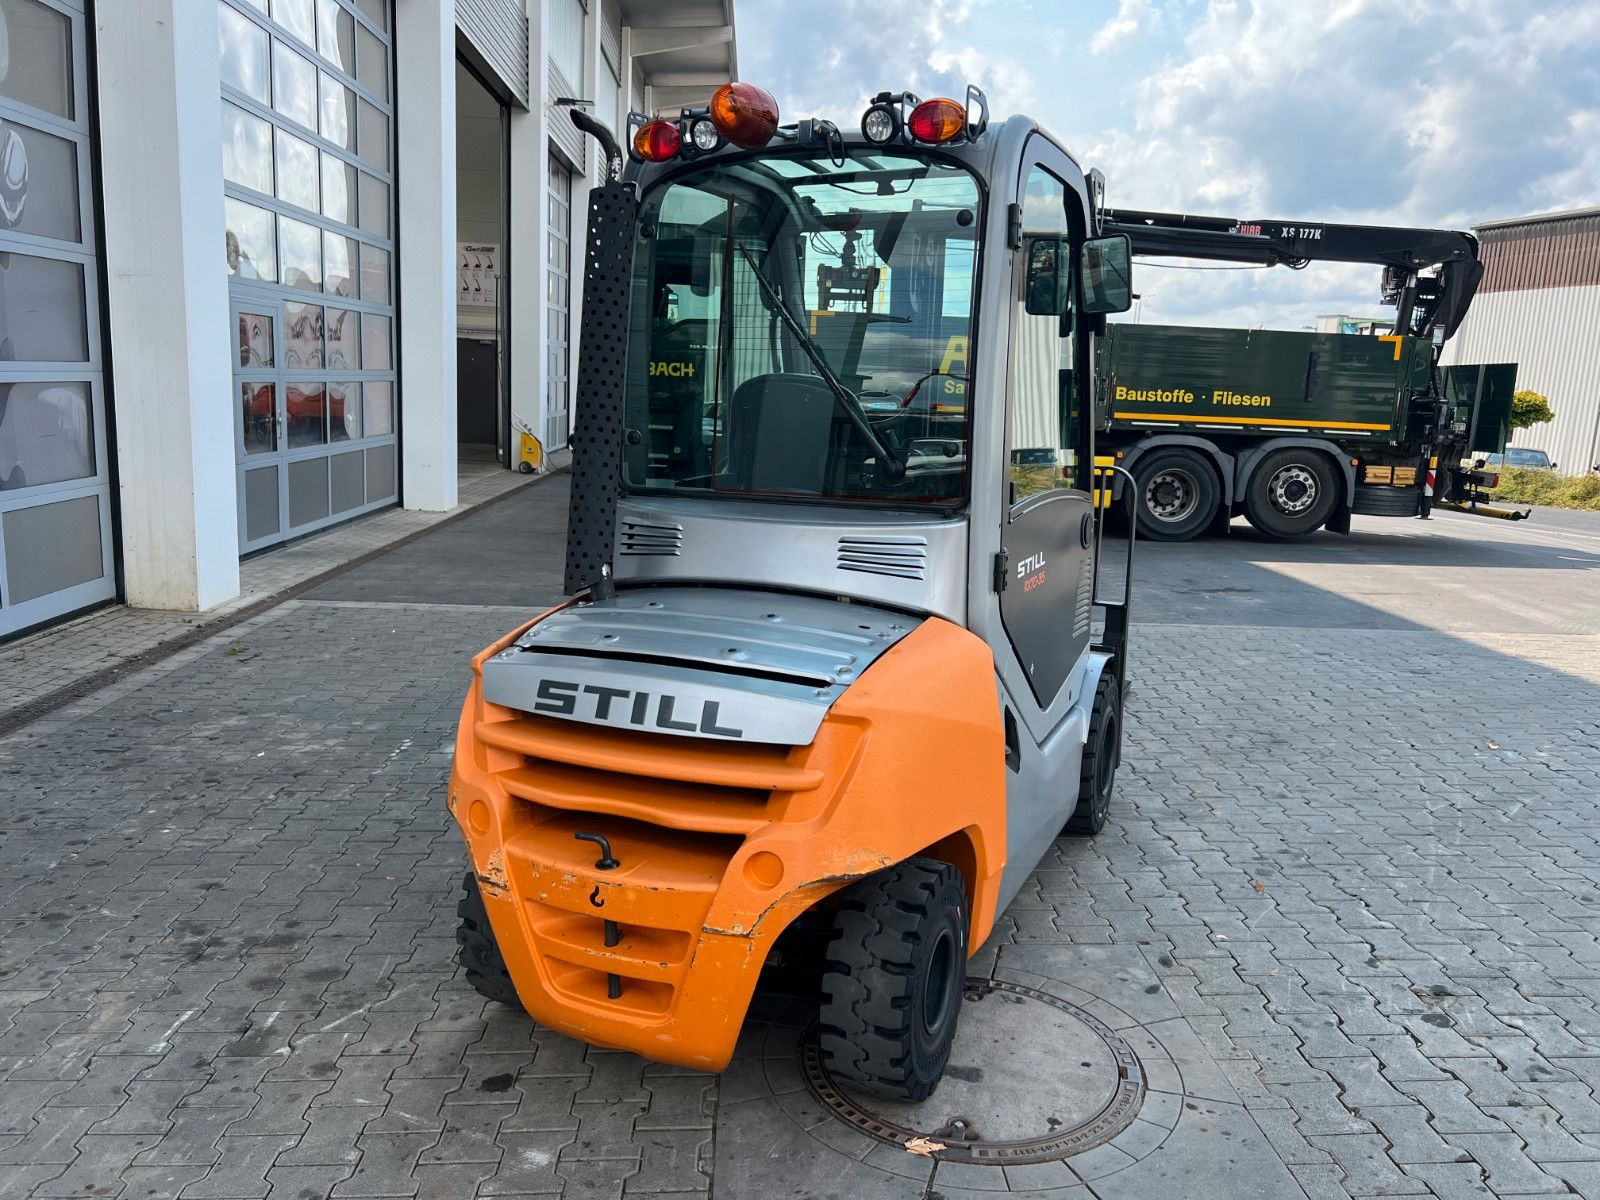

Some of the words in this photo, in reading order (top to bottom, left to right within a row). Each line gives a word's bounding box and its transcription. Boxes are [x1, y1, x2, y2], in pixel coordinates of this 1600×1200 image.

[1240, 225, 1261, 236] HIAB
[1281, 227, 1295, 238] XS
[1299, 228, 1322, 240] 177K
[1115, 386, 1194, 403] Baustoffe
[1212, 390, 1271, 407] Fliesen
[1017, 551, 1046, 579] STILL
[534, 679, 743, 738] STILL
